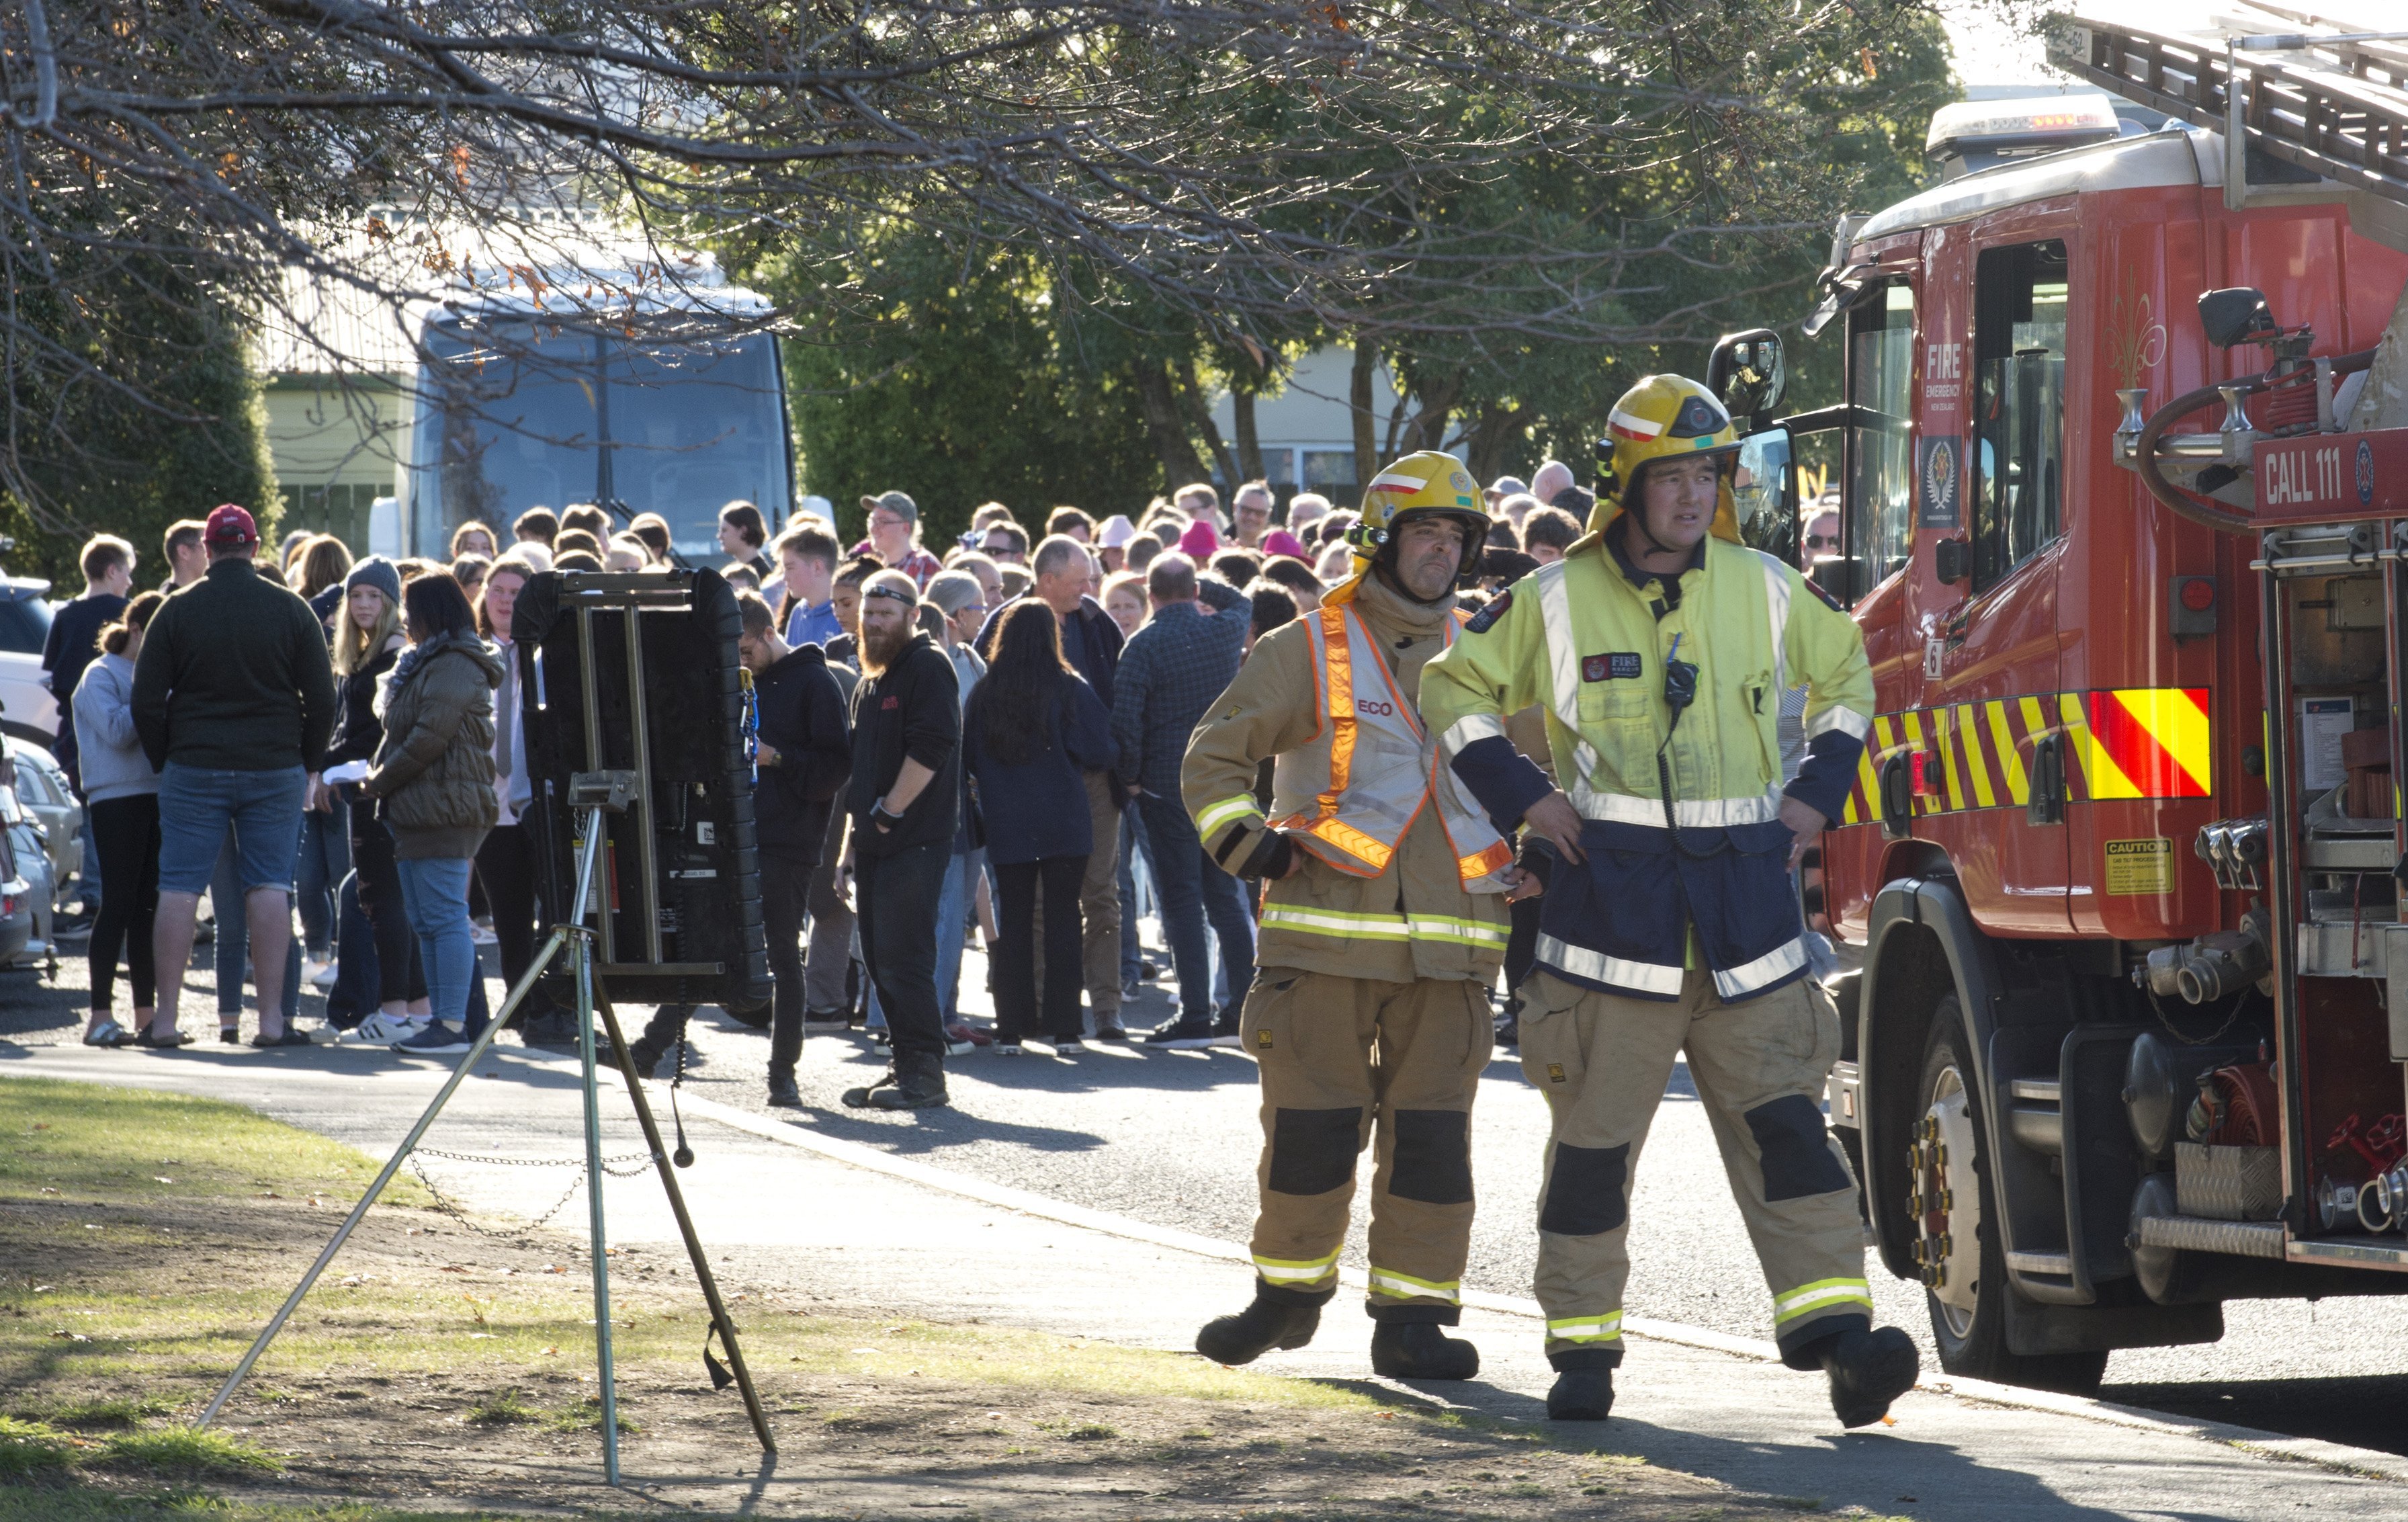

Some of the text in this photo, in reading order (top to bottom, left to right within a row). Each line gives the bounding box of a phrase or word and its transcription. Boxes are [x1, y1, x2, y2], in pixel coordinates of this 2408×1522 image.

[1927, 343, 1961, 379] FIRE
[1926, 384, 1960, 398] EMERGENCY
[2266, 450, 2313, 505] CALL
[2316, 447, 2341, 500] 111
[1612, 656, 1639, 666] FIRE
[1930, 645, 1936, 673] 6
[1358, 700, 1392, 716] ECO
[2109, 842, 2167, 853] CAUTION
